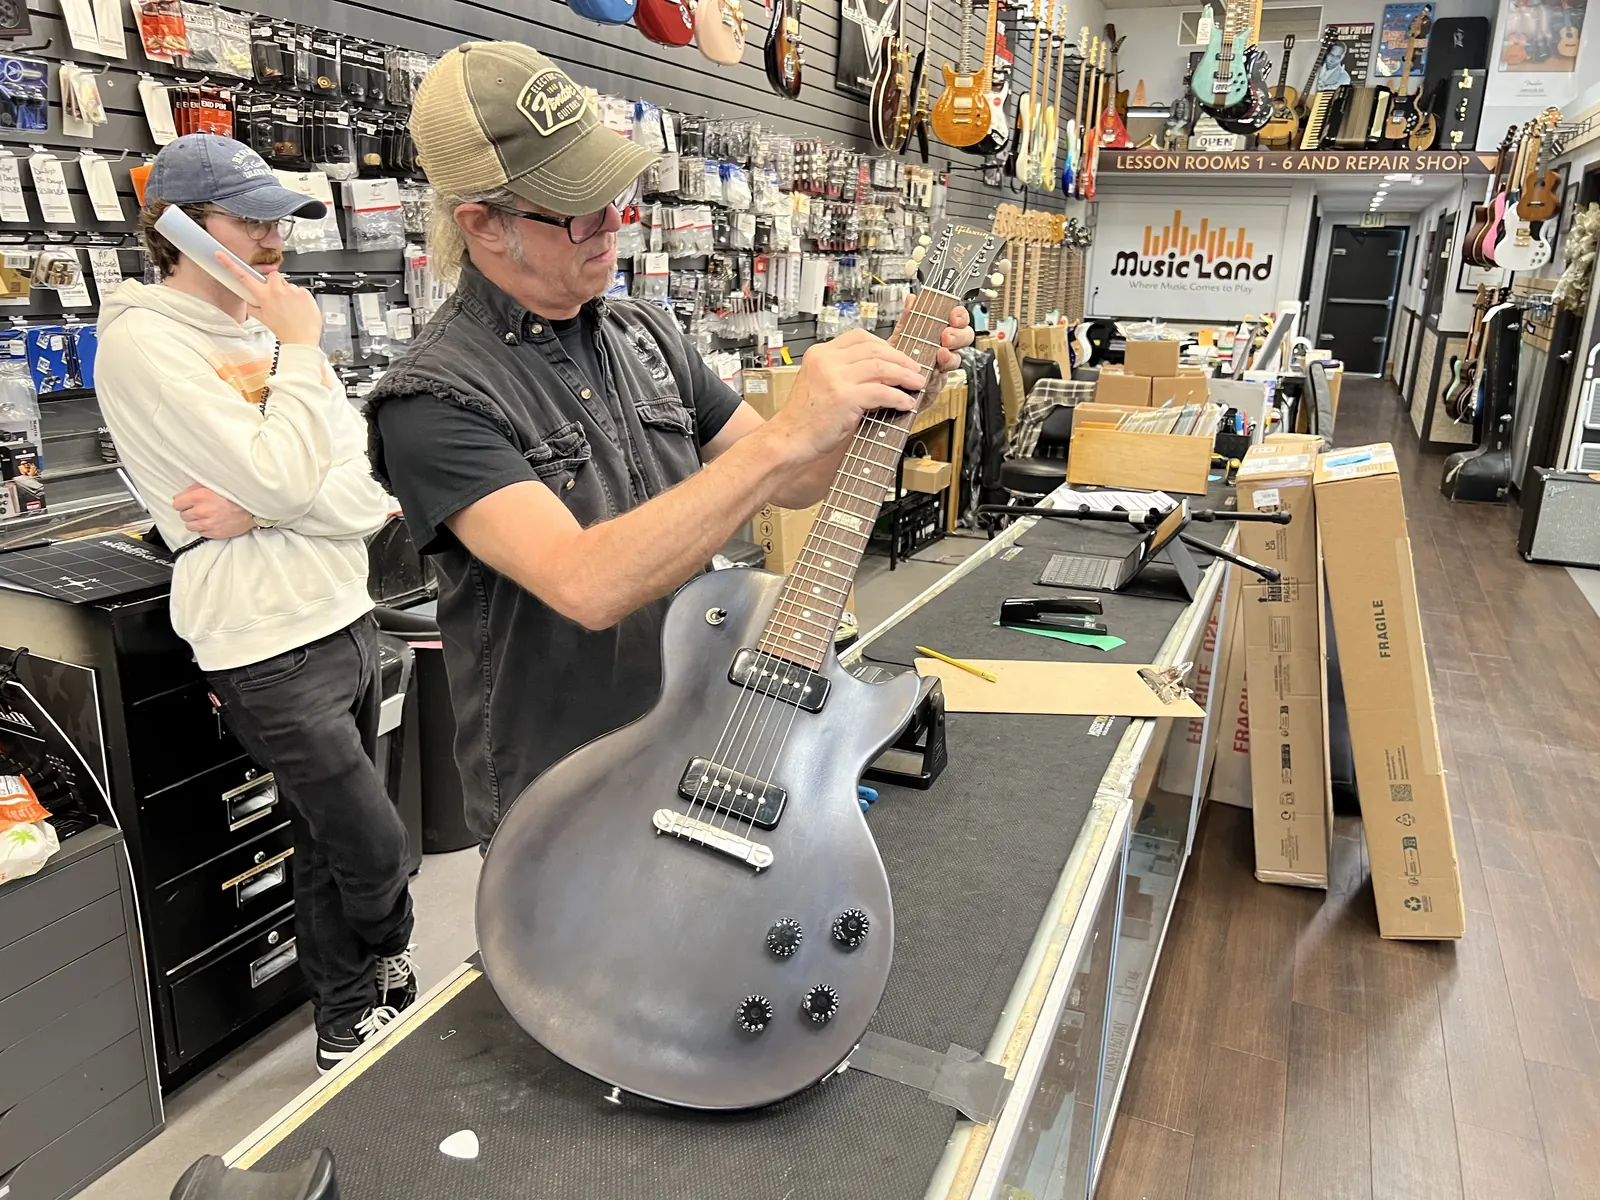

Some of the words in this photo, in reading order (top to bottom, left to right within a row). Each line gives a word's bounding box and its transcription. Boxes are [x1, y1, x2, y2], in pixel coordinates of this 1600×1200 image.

[531, 81, 576, 128] Fender
[1200, 137, 1233, 146] OPEN
[1116, 155, 1179, 170] LESSON
[1185, 155, 1250, 170] ROOMS
[1256, 155, 1264, 170] 1
[1282, 156, 1293, 170] 6
[1298, 155, 1340, 170] AND
[1345, 155, 1410, 170] REPAIR
[1415, 155, 1470, 171] SHOP
[1365, 213, 1383, 226] EXIT
[1129, 280, 1158, 289] Where
[1160, 281, 1187, 290] Music
[1190, 283, 1220, 292] Comes
[1222, 284, 1232, 292] to
[1235, 284, 1253, 294] Play
[1547, 485, 1570, 498] Fender
[1372, 600, 1391, 658] FRAGILE
